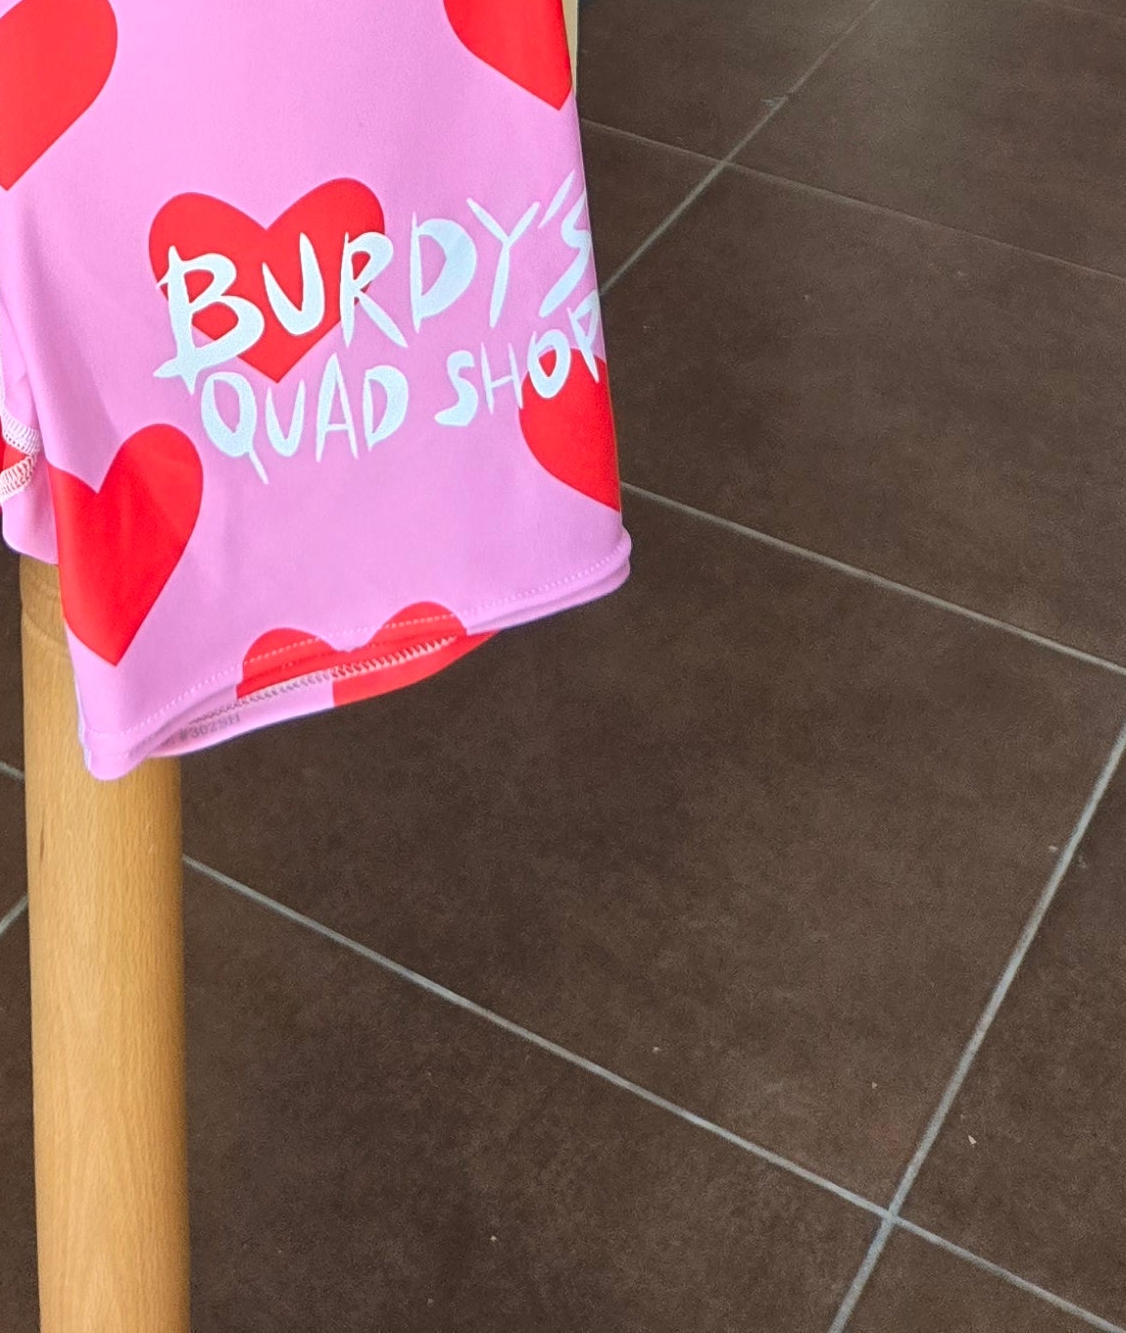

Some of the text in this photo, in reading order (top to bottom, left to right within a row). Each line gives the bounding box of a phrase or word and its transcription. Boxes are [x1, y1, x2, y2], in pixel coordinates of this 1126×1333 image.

[153, 169, 592, 396] BURDY'S
[201, 353, 409, 485] QUAD
[435, 289, 601, 427] SHOP
